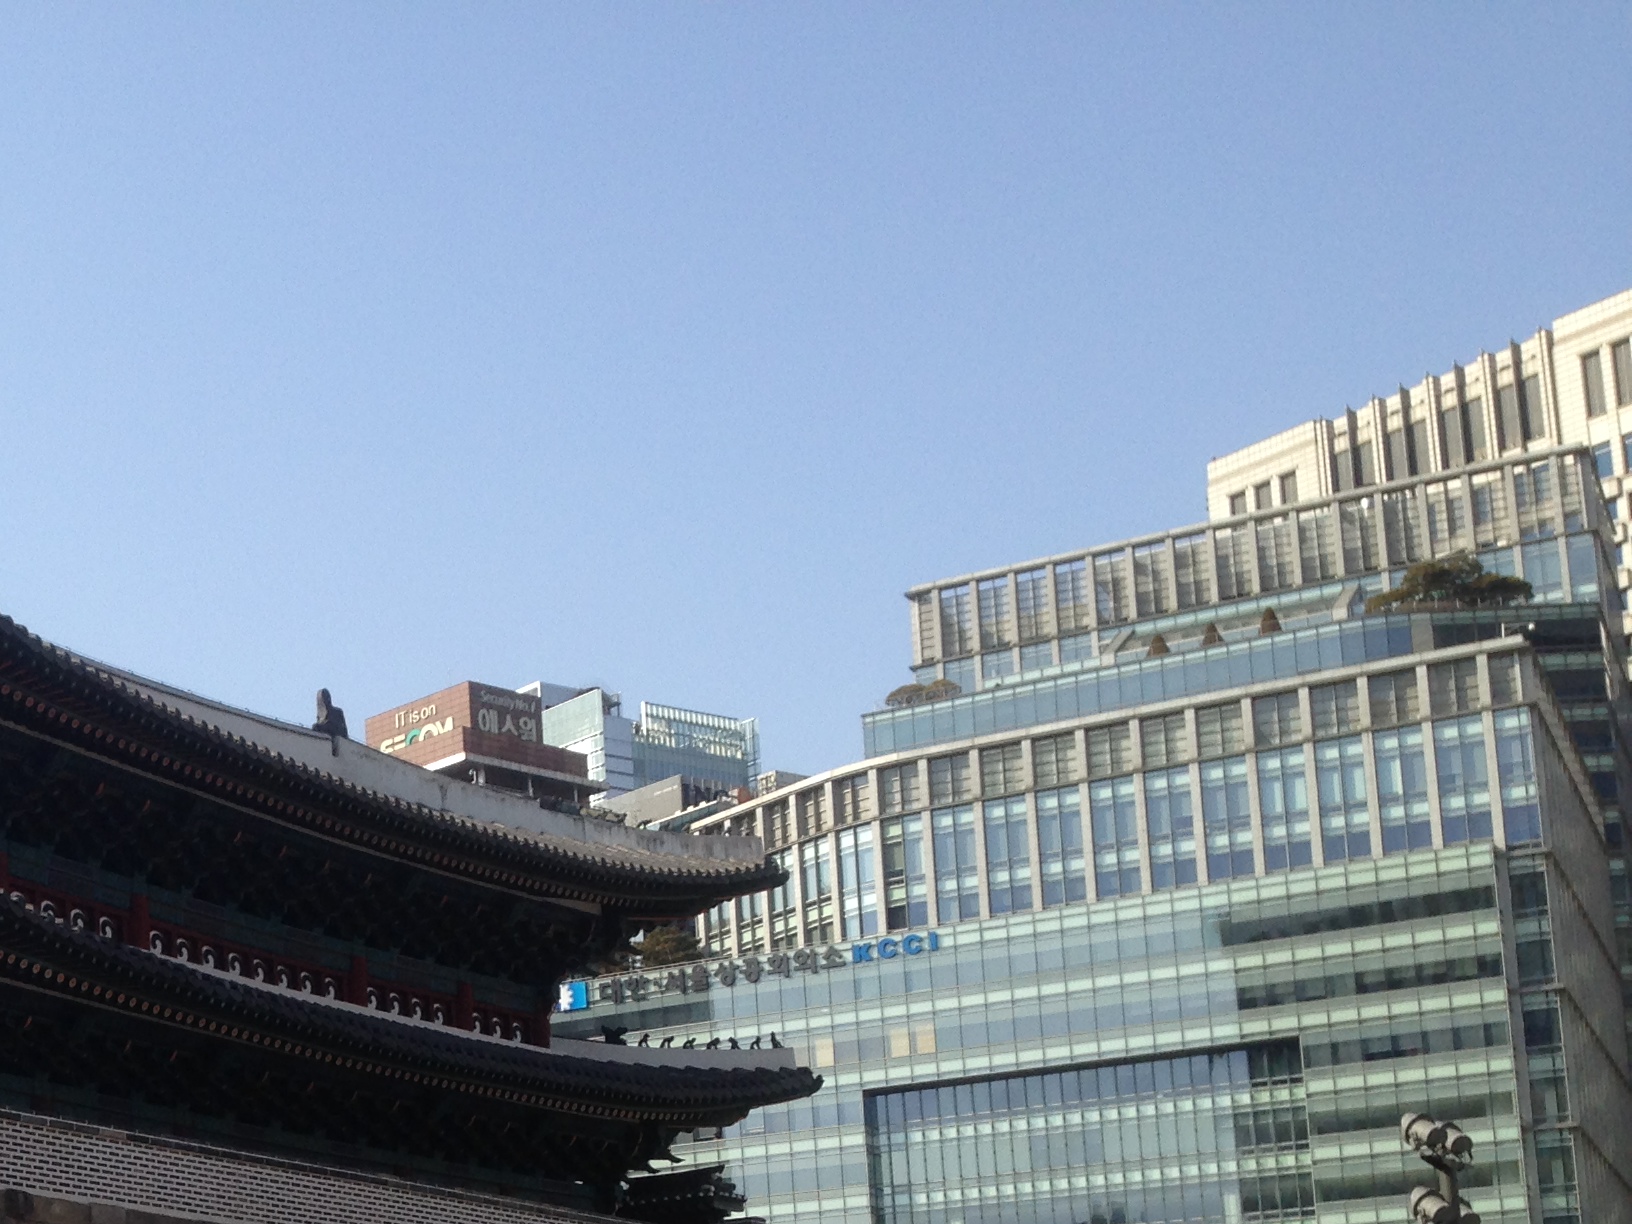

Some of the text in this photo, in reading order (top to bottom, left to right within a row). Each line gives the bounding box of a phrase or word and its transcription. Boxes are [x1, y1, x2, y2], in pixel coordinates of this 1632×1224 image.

[395, 704, 437, 729] IT is on
[478, 708, 537, 742] 에스원
[852, 931, 939, 964] KCCI
